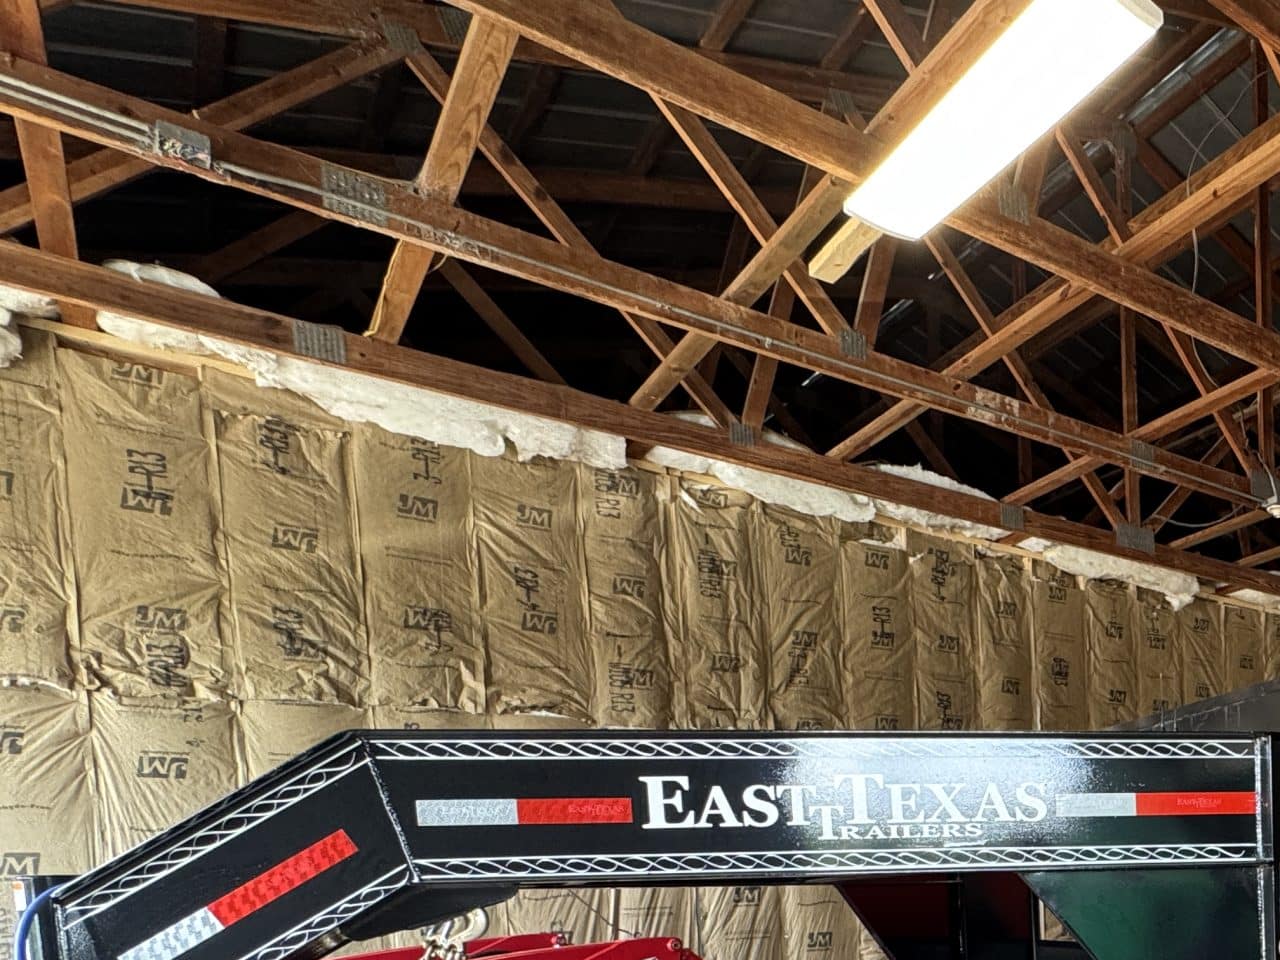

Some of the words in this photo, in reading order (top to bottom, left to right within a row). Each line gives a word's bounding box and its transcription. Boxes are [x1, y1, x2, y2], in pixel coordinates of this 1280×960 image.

[397, 494, 438, 520] JM
[517, 504, 552, 530] JM
[272, 527, 318, 553] JM
[785, 549, 812, 566] JM
[613, 576, 646, 598] JM
[136, 605, 187, 630] JM
[521, 613, 557, 634] JM
[137, 756, 189, 779] JM
[638, 775, 818, 829] EAST
[834, 773, 1048, 825] TEXAS
[809, 805, 984, 840] TRAILERS
[807, 932, 832, 947] JM
